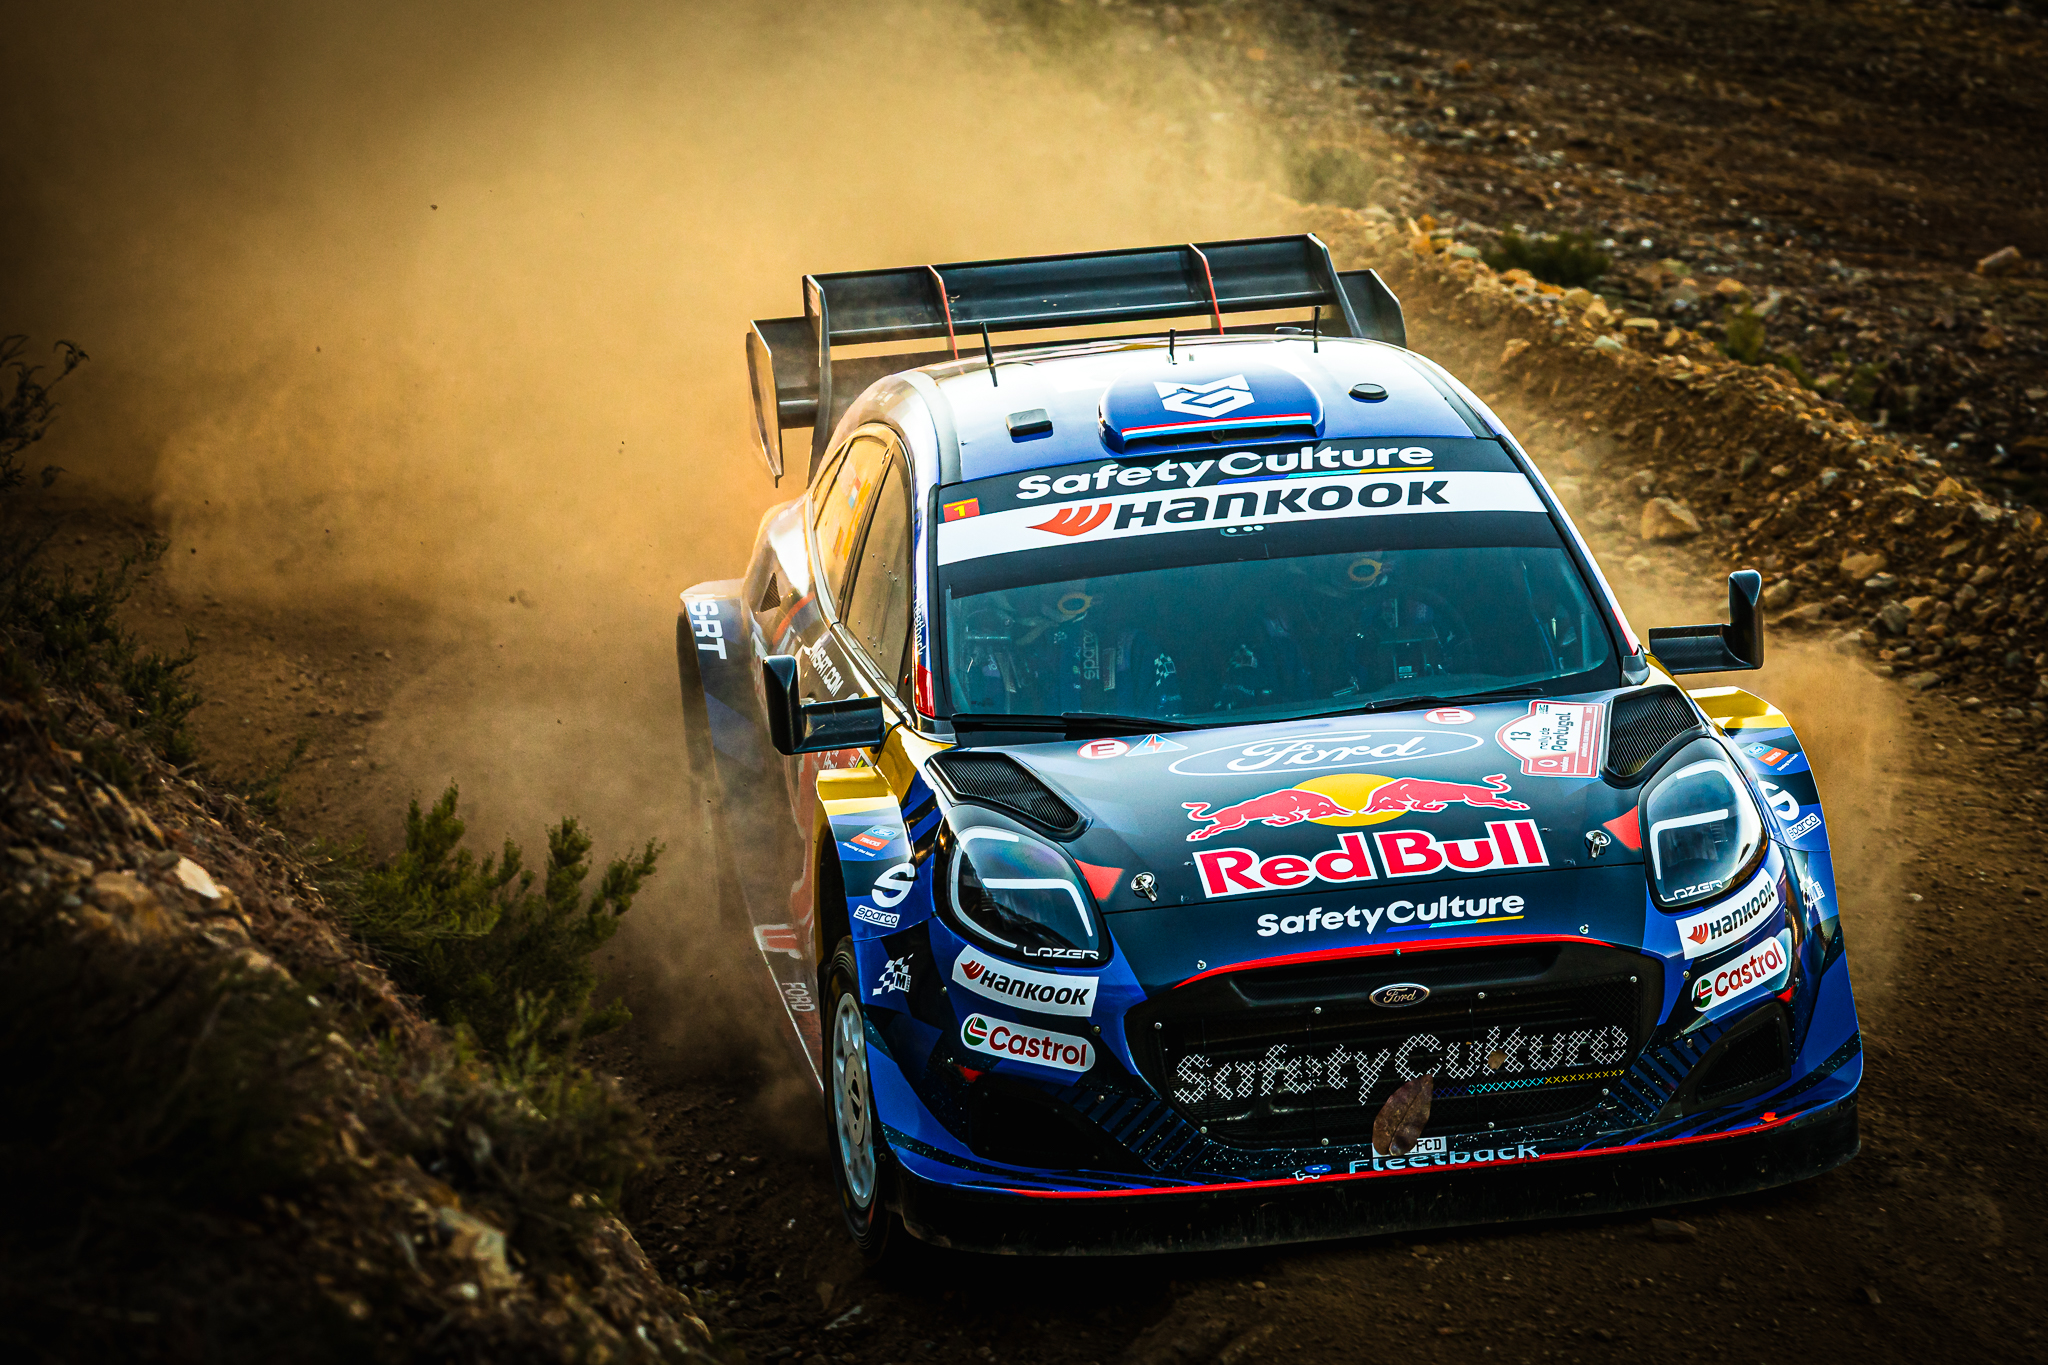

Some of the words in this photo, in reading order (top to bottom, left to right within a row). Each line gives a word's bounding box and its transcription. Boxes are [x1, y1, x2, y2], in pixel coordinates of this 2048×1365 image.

[1016, 446, 1434, 500] SafetyCulture
[953, 504, 966, 517] 1
[686, 594, 727, 660] S-RT
[1436, 711, 1464, 723] E
[1551, 712, 1574, 752] Portugal
[1091, 742, 1116, 757] E
[1510, 731, 1532, 741] 13
[1226, 734, 1427, 771] Ford
[1193, 832, 1378, 898] Red
[1373, 819, 1550, 879] Bull
[1660, 879, 1723, 903] LAZER
[856, 907, 898, 927] sparco
[1257, 895, 1525, 937] SafetyCulture
[1023, 946, 1100, 960] LAZER
[1715, 942, 1783, 997] Castrol
[781, 982, 816, 1012] FORD
[1383, 987, 1417, 1003] Ford
[989, 1026, 1088, 1067] Castrol
[1173, 1025, 1629, 1106] SafetyCulture
[1349, 1144, 1541, 1174] Fleetback
[1416, 1137, 1442, 1154] FCD
